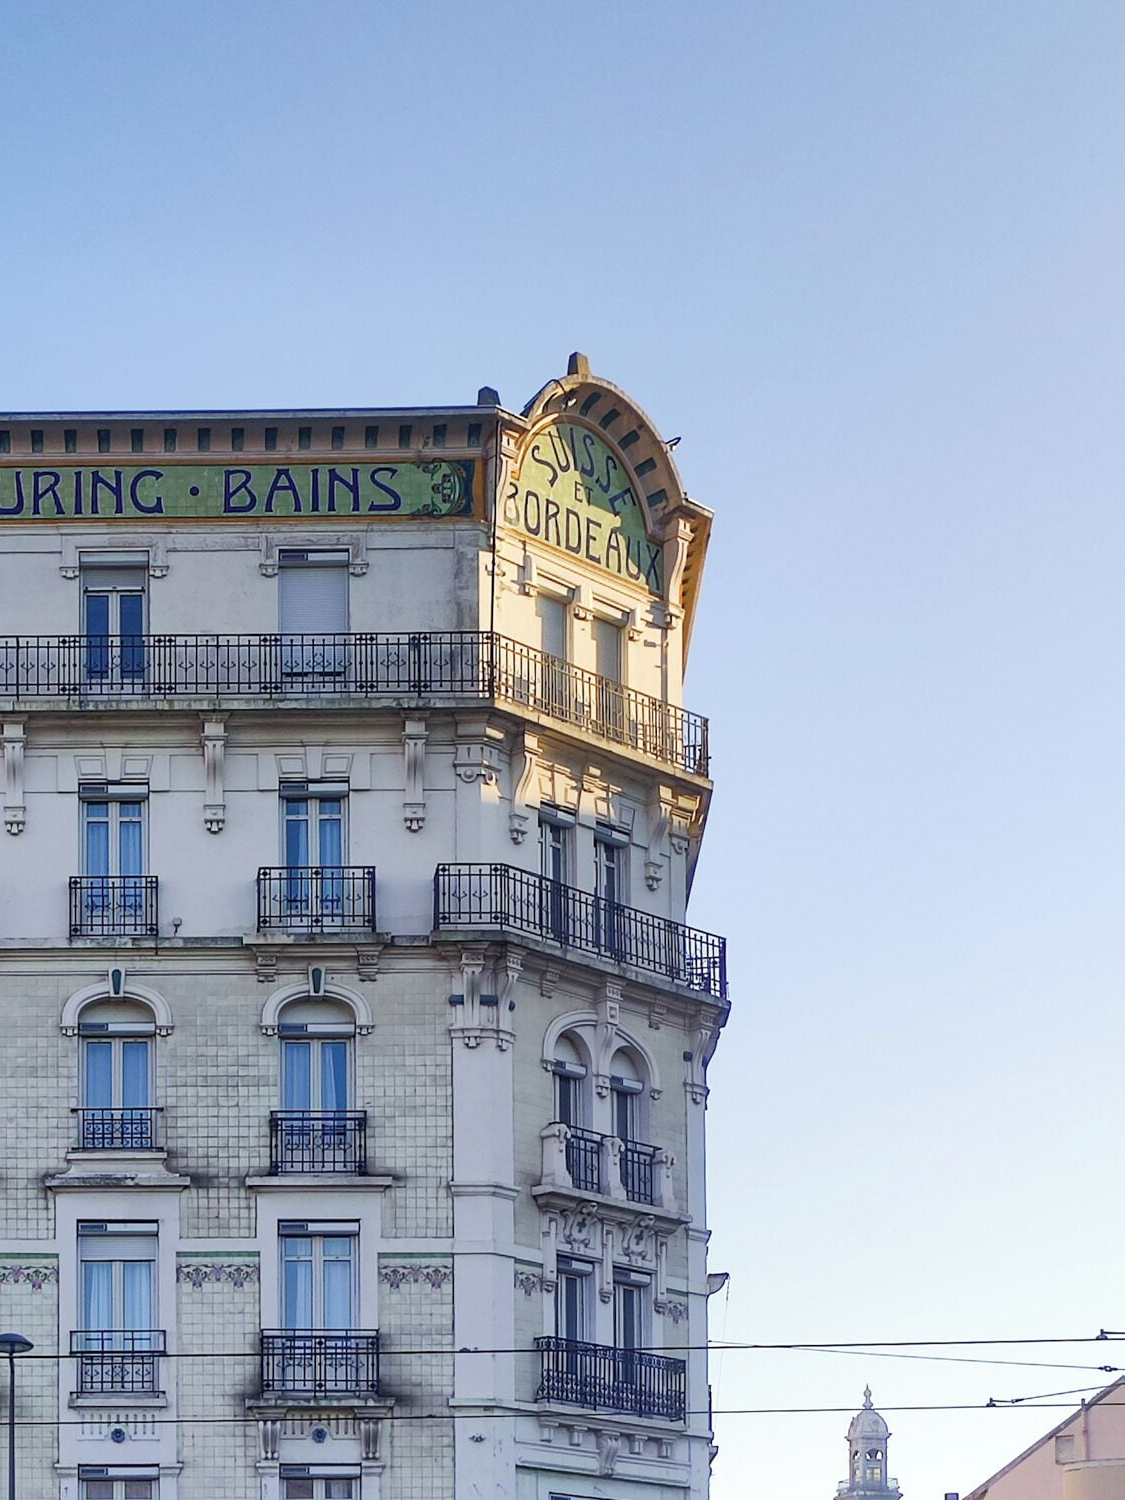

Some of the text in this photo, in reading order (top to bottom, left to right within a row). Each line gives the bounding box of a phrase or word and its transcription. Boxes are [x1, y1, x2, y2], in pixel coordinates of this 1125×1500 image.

[222, 467, 403, 514] BAINS
[531, 427, 638, 517] SUISSE
[574, 480, 594, 507] ET
[503, 481, 661, 591] BORDEAUX
